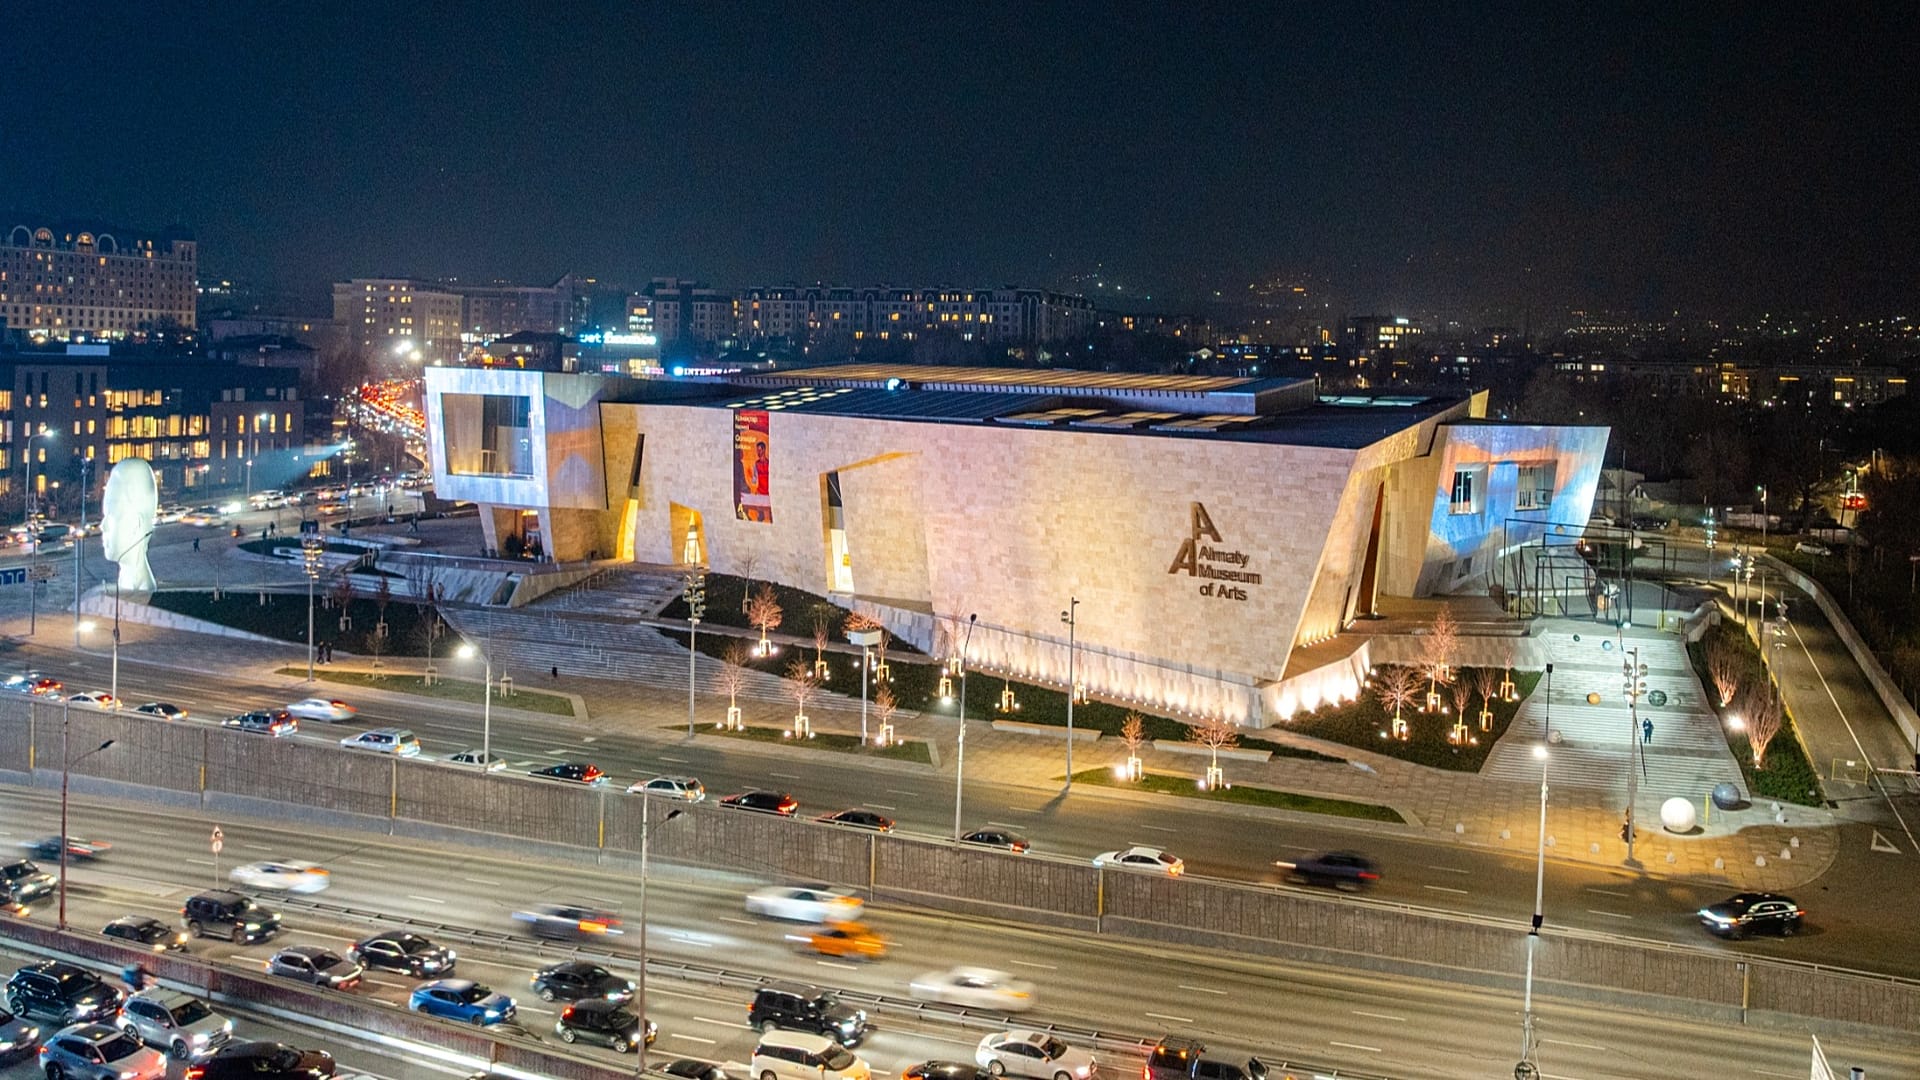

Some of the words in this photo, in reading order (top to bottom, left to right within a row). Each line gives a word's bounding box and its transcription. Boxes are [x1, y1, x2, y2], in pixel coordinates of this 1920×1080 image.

[1198, 545, 1250, 569] Almaty
[1198, 564, 1262, 585] Museum
[1199, 582, 1215, 597] of
[1217, 584, 1248, 602] Arts
